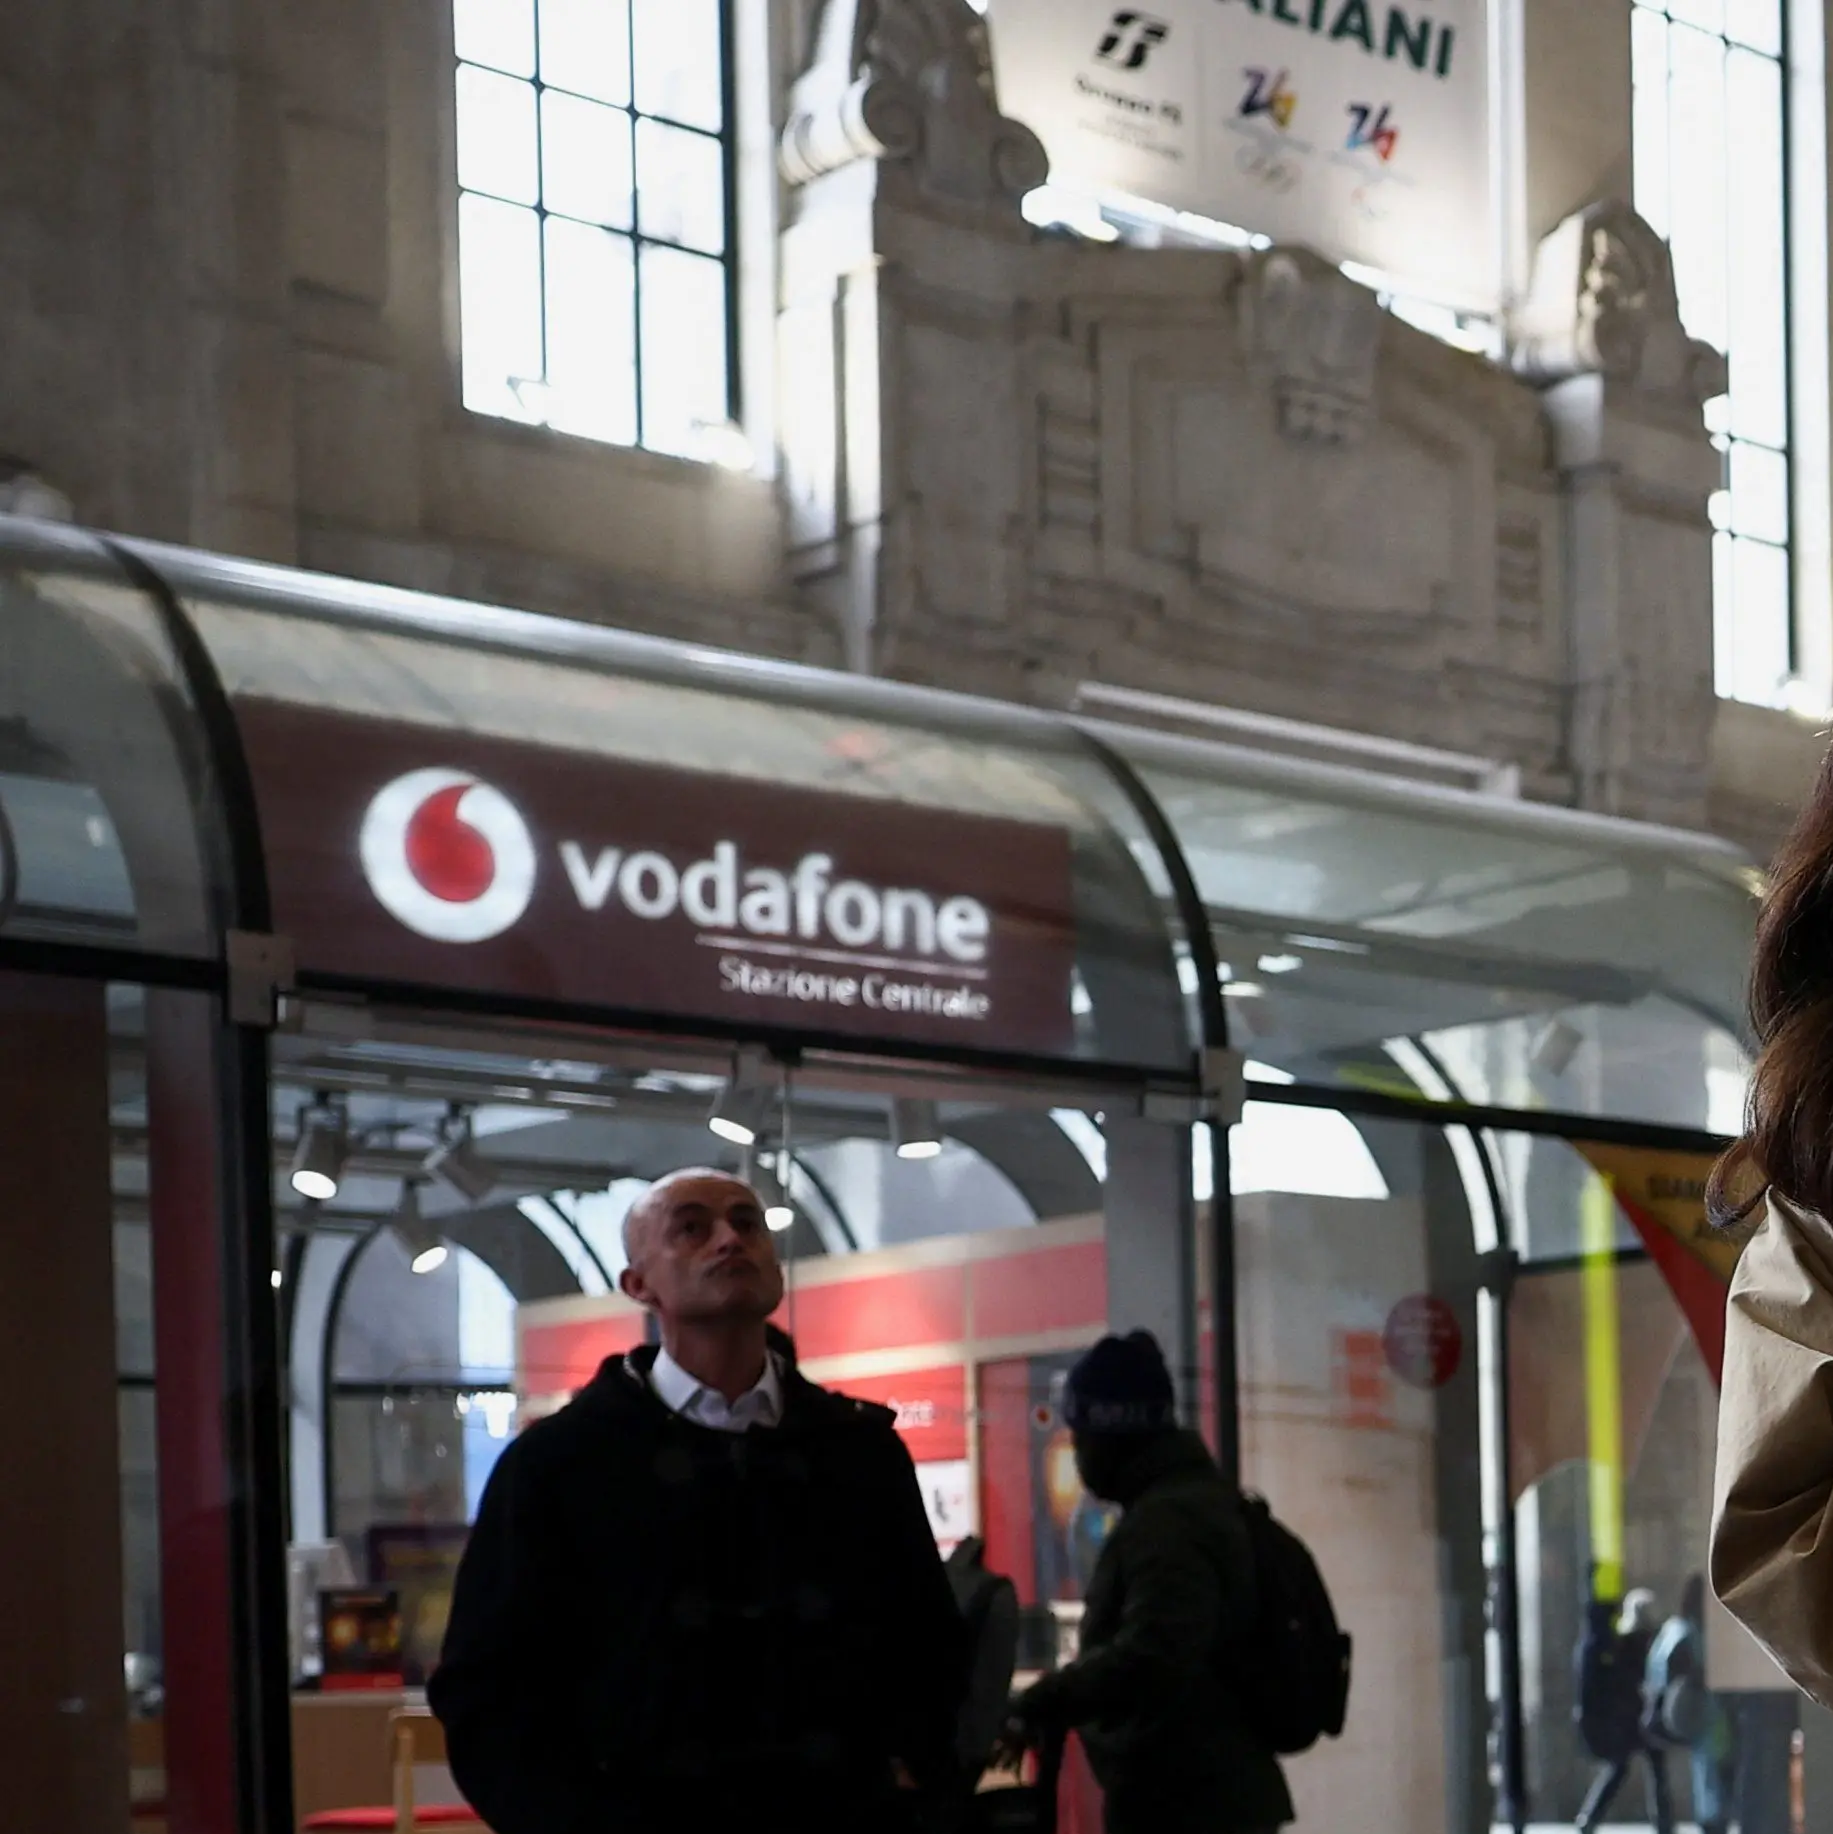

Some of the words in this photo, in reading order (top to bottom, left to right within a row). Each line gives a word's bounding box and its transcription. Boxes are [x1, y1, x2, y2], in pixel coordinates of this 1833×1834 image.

[558, 839, 991, 961] vodafone
[718, 954, 860, 1007] Stazione
[861, 972, 991, 1021] Centrale
